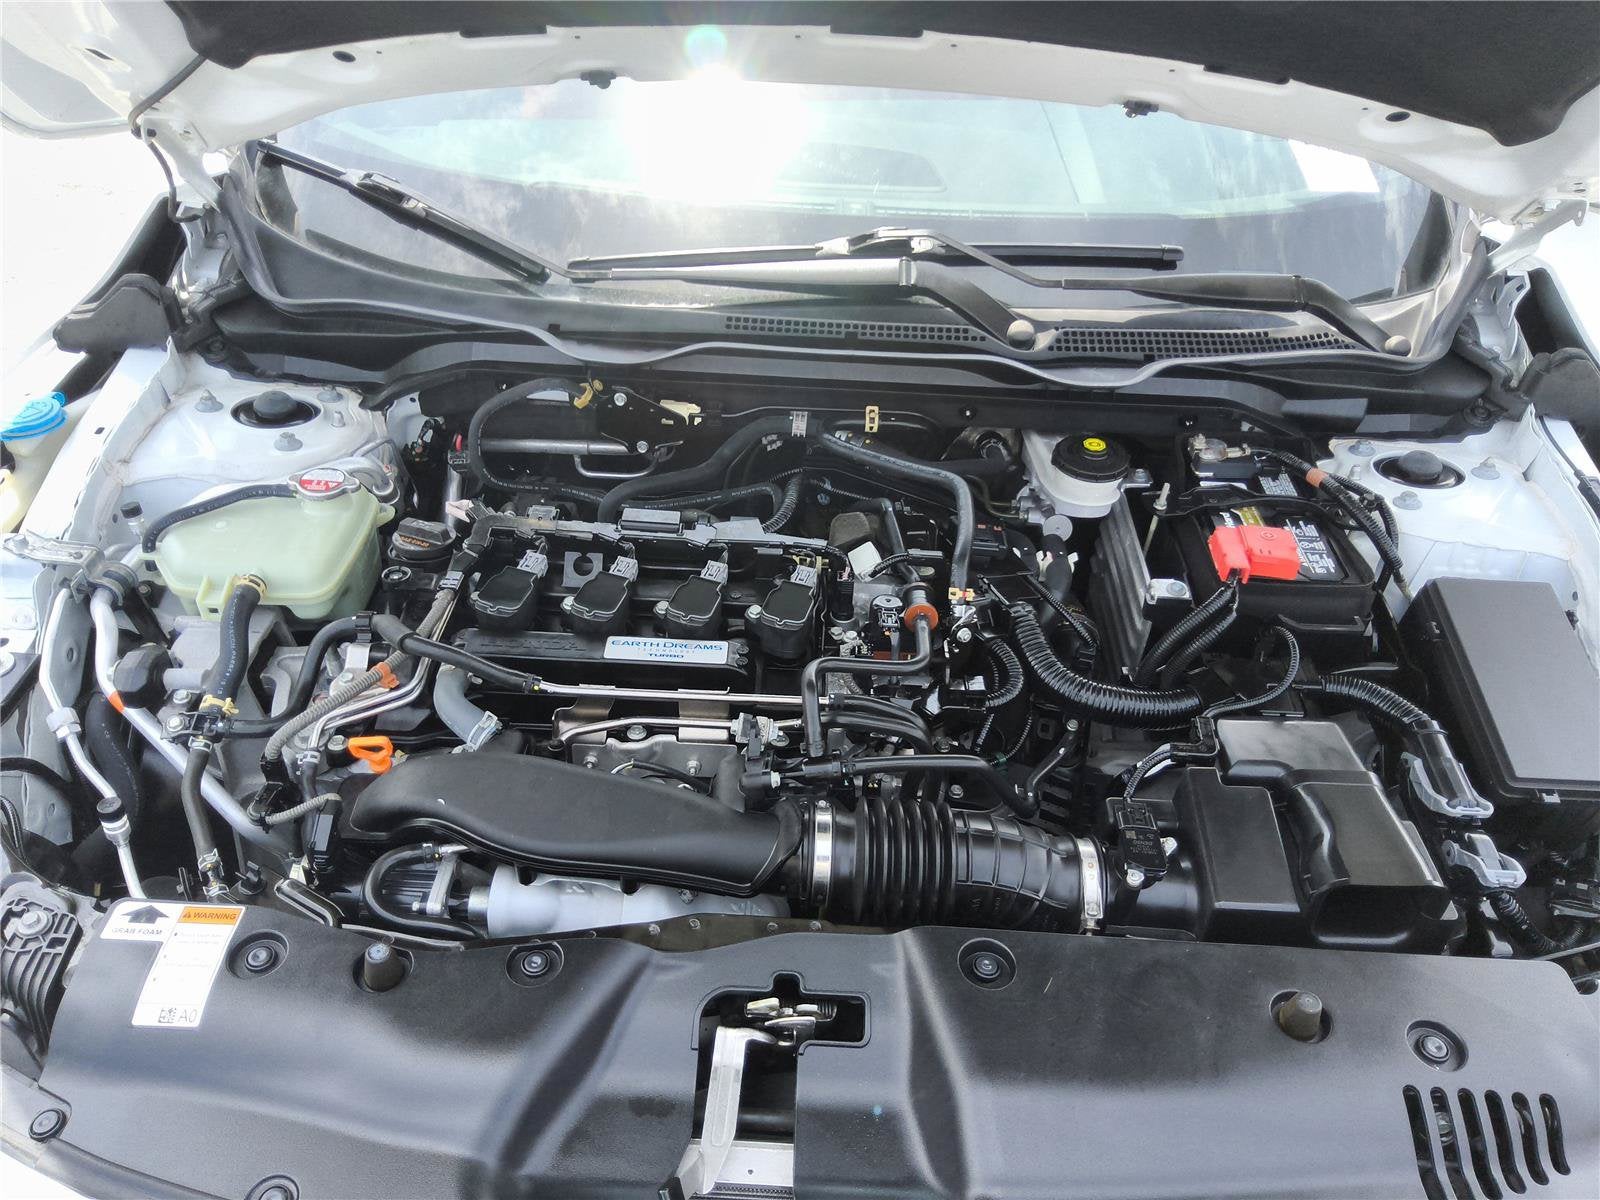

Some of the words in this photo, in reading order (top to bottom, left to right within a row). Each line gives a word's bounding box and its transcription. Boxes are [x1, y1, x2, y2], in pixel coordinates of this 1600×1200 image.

[611, 639, 660, 648] EARTH
[663, 641, 723, 651] DREAMS
[193, 912, 237, 920] WARNING
